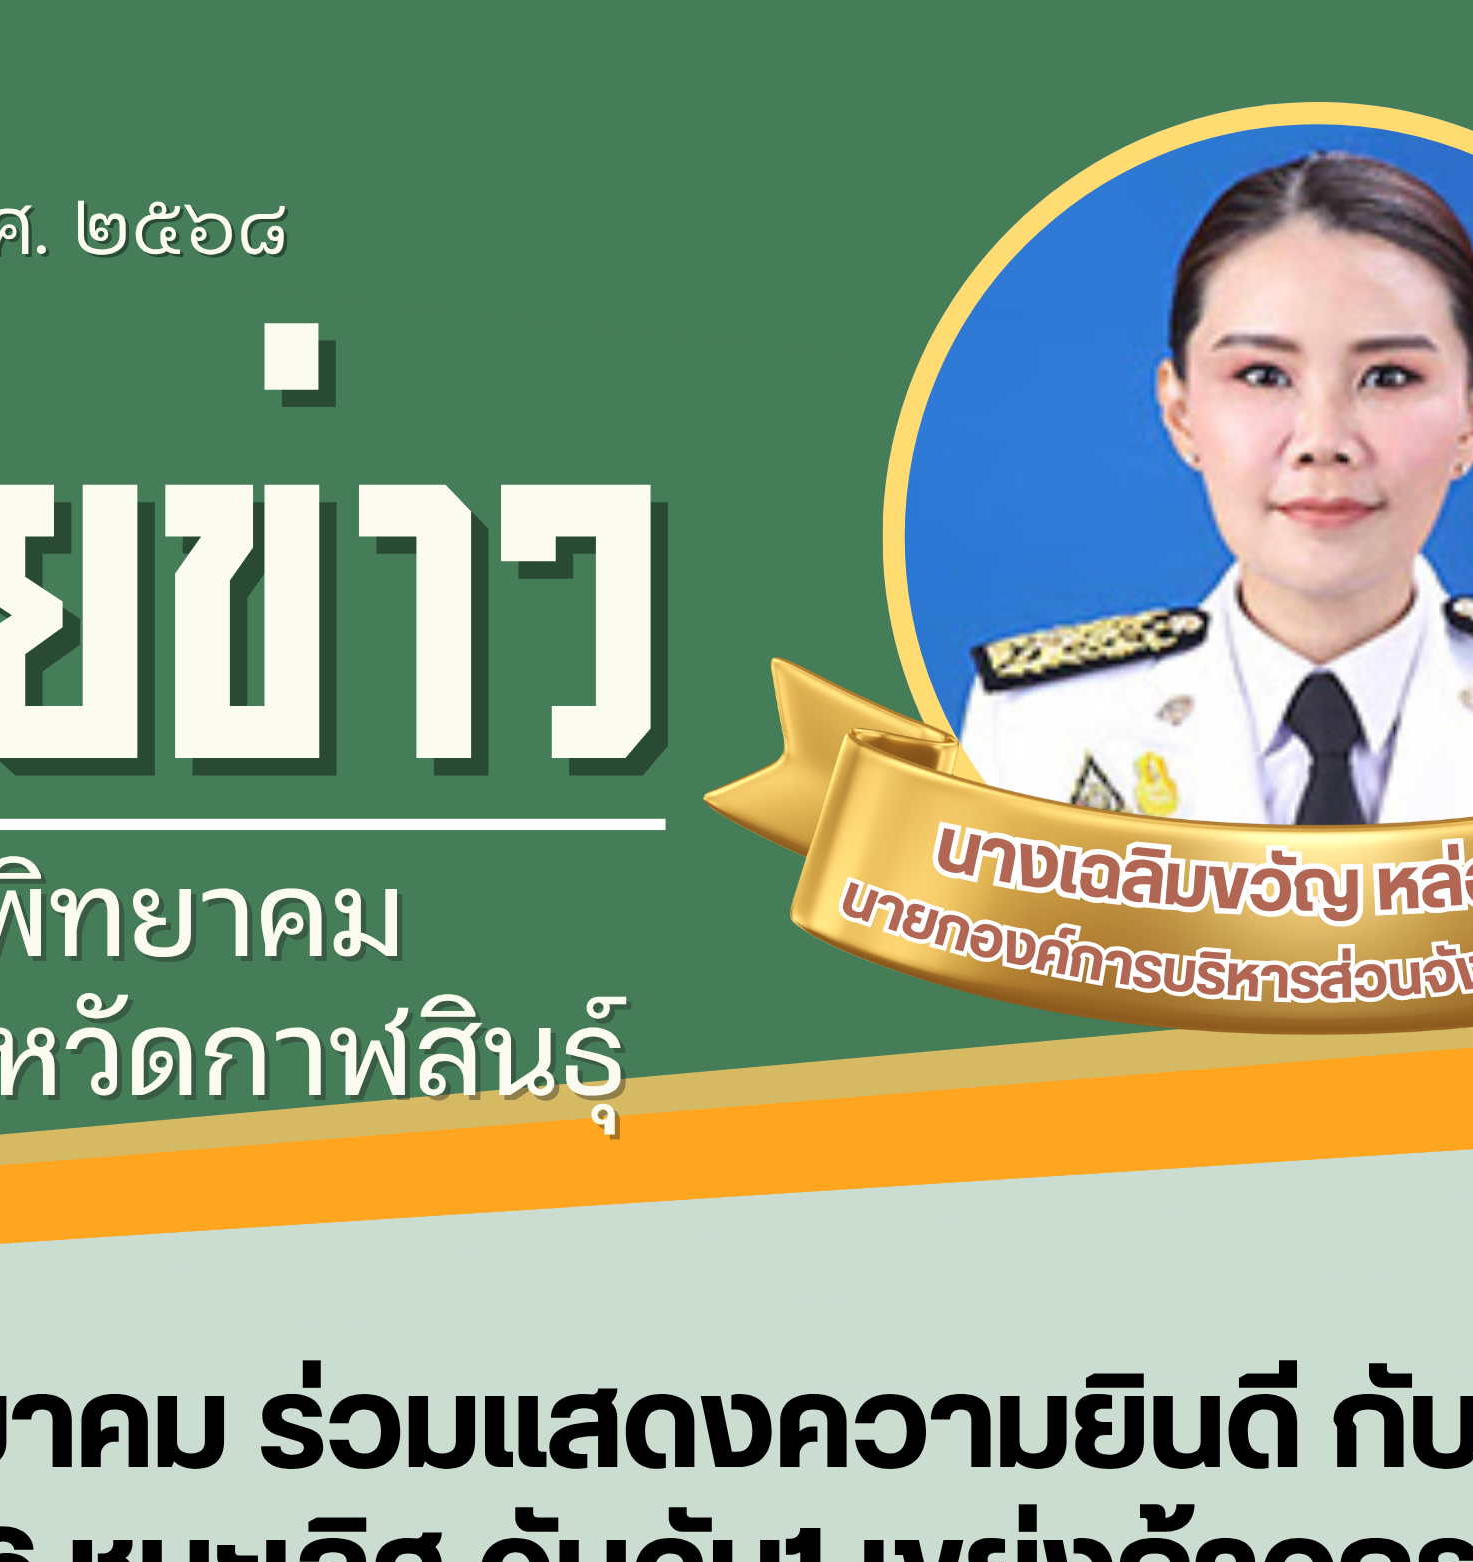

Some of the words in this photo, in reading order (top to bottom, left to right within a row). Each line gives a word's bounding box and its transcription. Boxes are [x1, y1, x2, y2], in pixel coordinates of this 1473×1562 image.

[76, 199, 286, 256] ๒๕๖๘
[933, 822, 1363, 922] นางเฉลิมขวัญ
[259, 1358, 1299, 1471] ร่วมแสดงความยินดี
